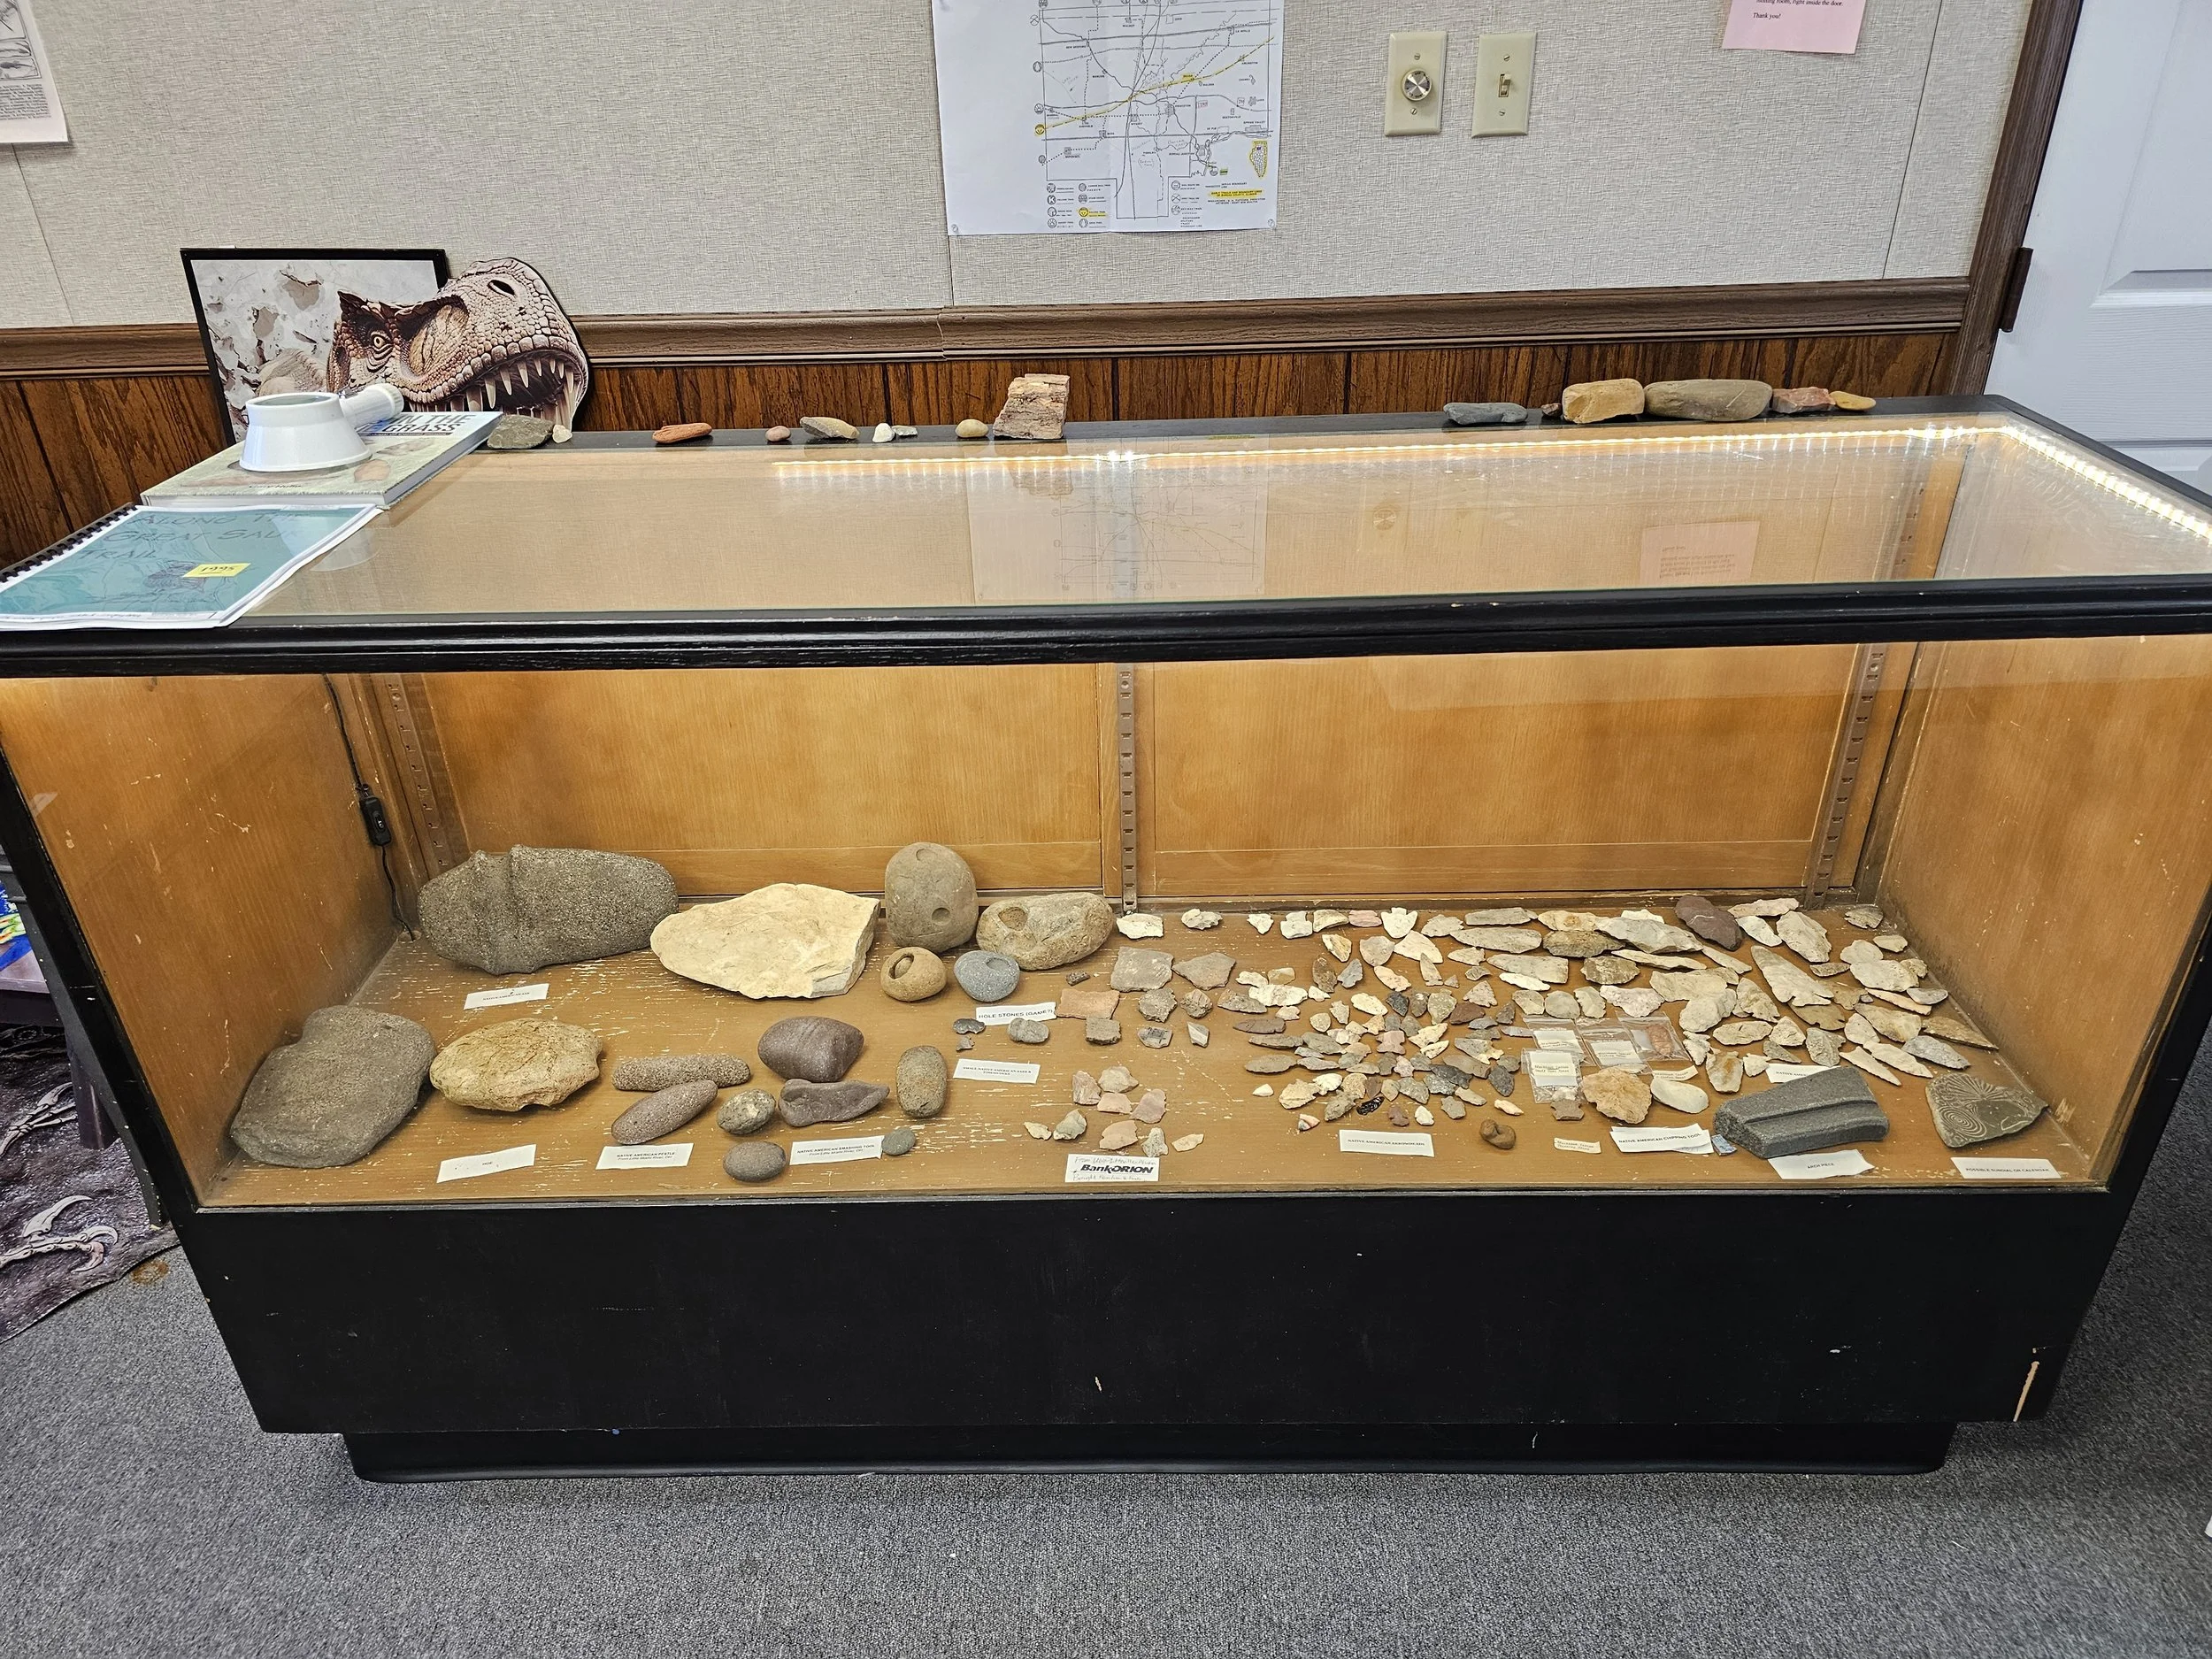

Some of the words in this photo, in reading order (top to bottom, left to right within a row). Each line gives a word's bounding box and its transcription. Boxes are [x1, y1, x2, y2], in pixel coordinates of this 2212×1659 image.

[426, 414, 475, 424] THE
[381, 423, 461, 432] GRASS
[127, 513, 237, 525] ALONG
[103, 530, 208, 541] GREAT
[80, 549, 157, 559] TRAIL
[1080, 1164, 1154, 1174] BankORION
